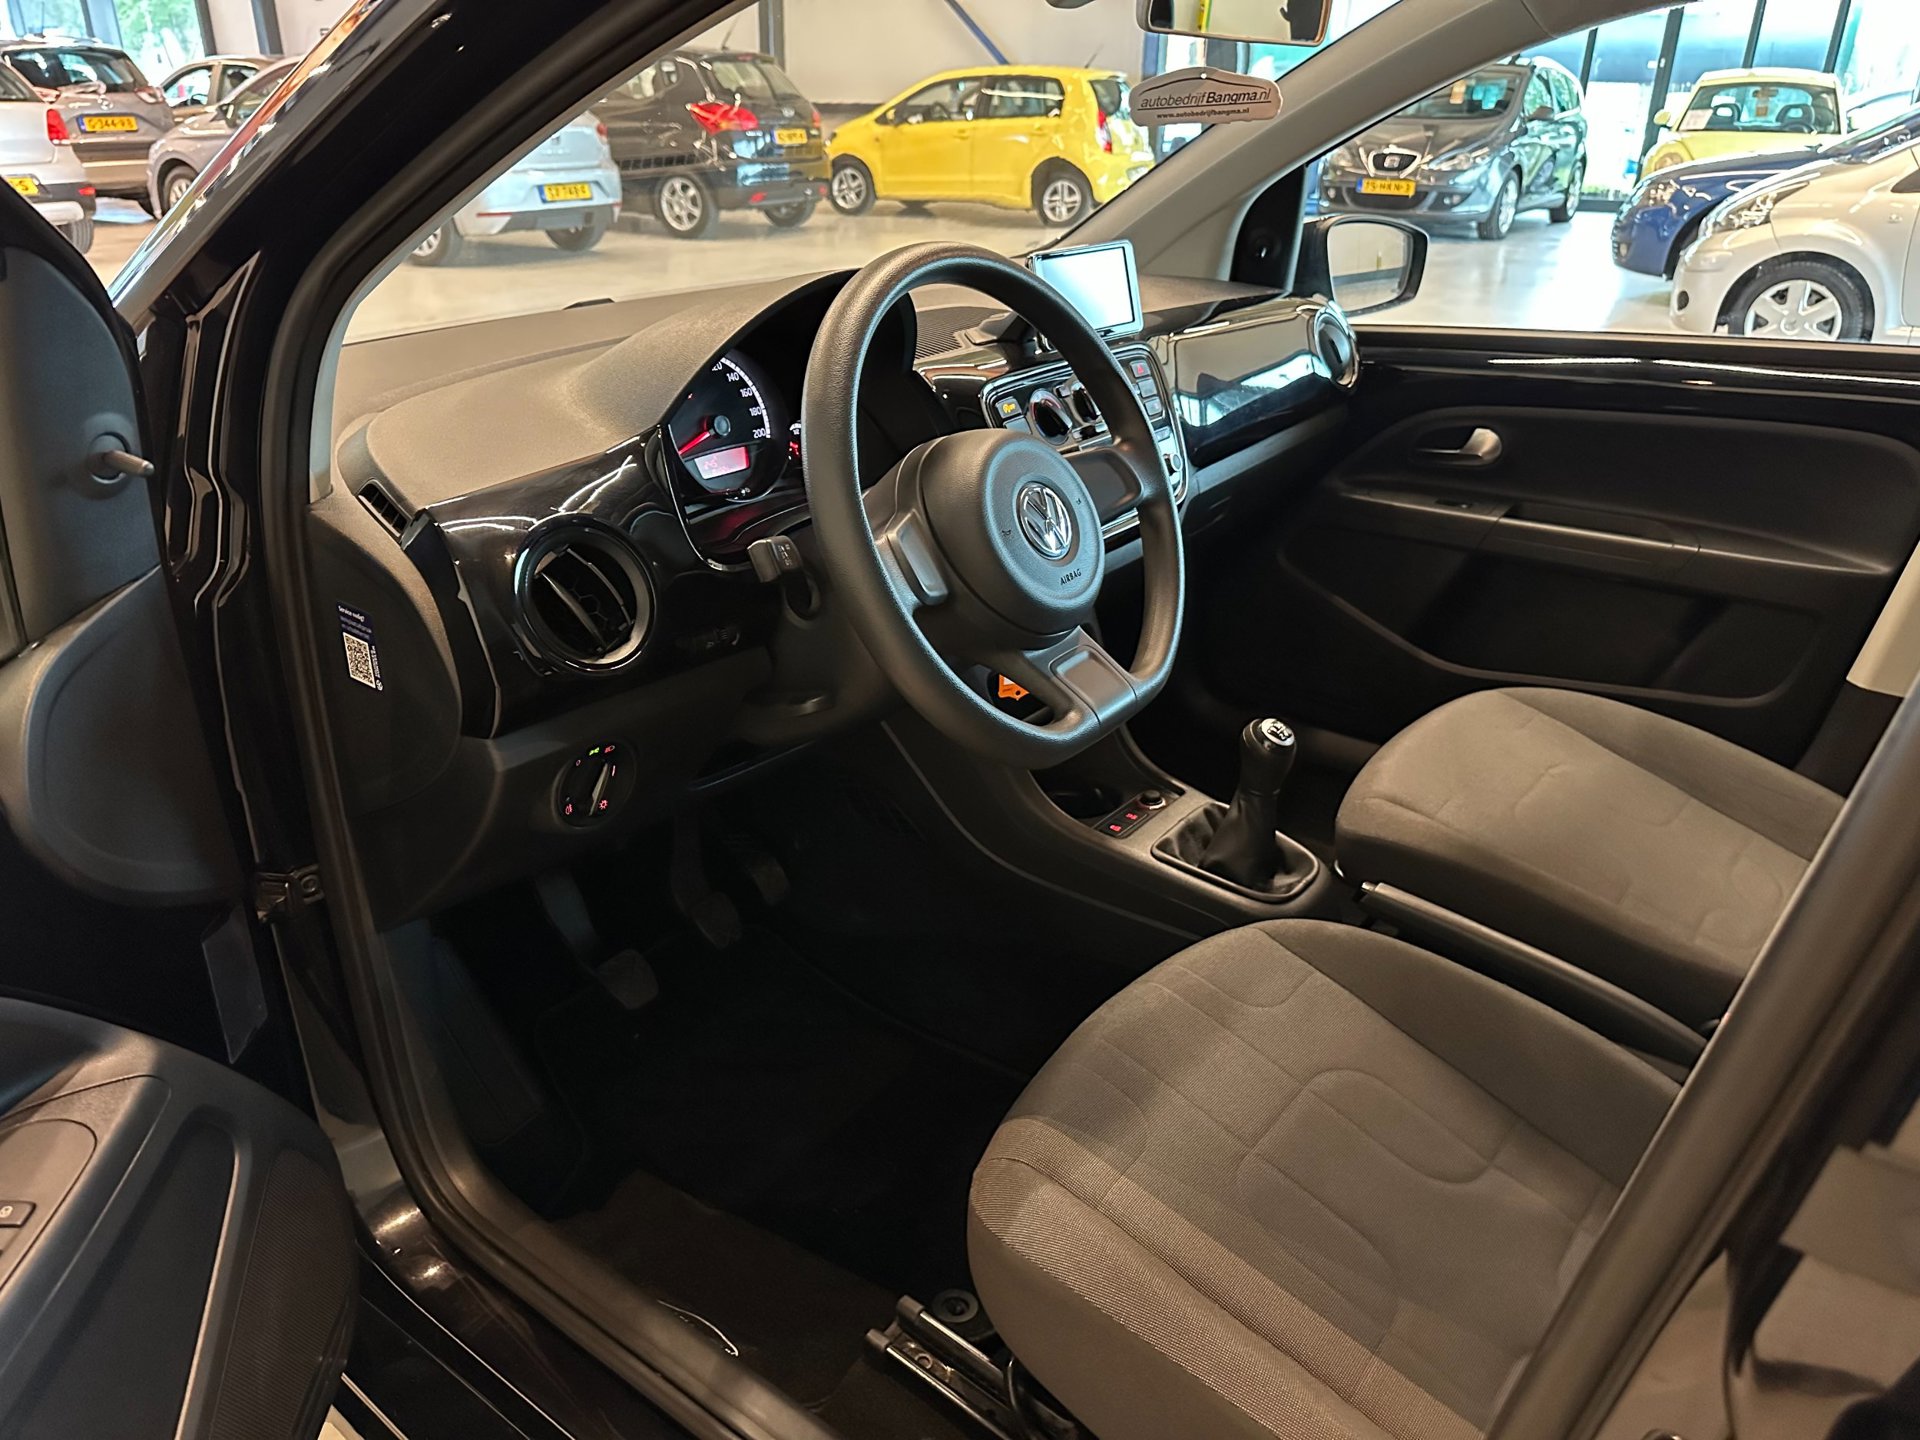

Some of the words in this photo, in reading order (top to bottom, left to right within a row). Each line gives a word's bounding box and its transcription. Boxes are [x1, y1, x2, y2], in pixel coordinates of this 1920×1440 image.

[1156, 107, 1250, 119] www.autobedrijfbangma.nl
[726, 372, 740, 382] 140
[740, 387, 753, 398] 160
[749, 406, 762, 417] 180
[752, 427, 767, 439] 200
[1060, 568, 1082, 585] AIRBAG
